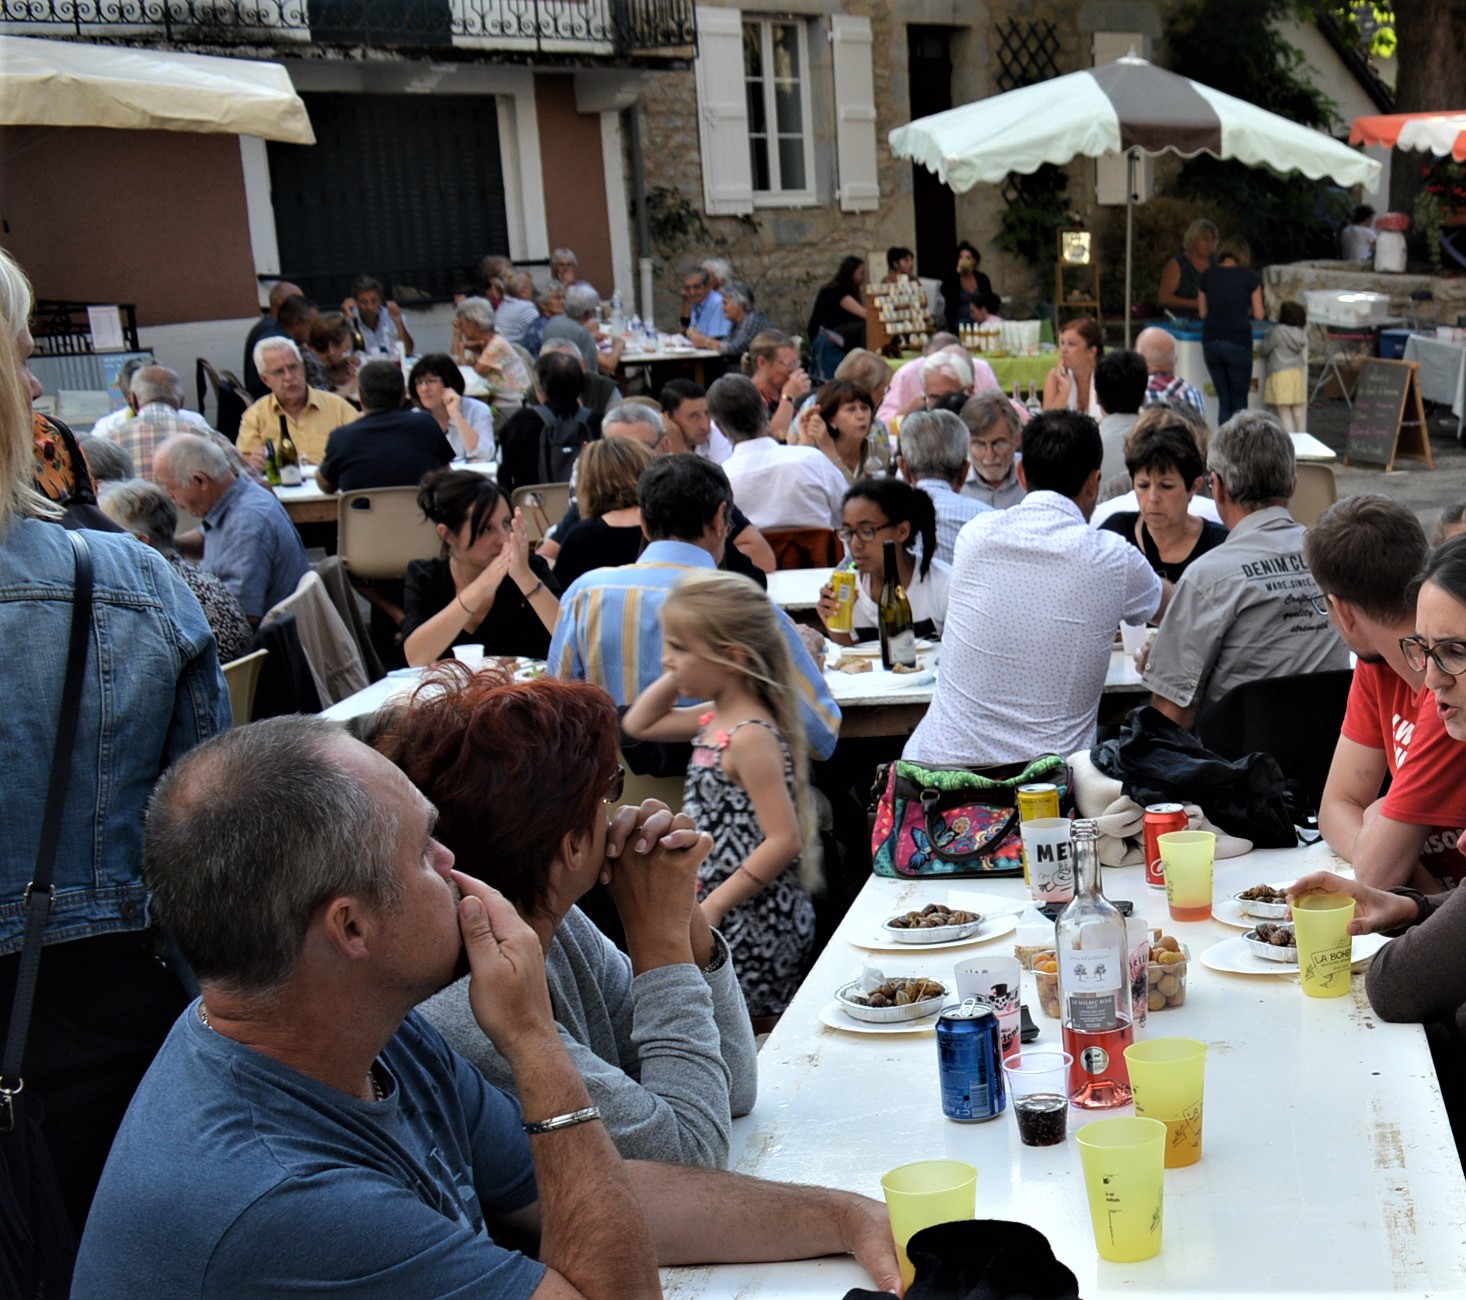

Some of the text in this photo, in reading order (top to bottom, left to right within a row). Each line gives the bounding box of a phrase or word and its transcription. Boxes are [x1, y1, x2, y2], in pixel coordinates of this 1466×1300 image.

[1241, 554, 1309, 578] DENIM CL
[1283, 609, 1314, 621] quality
[1314, 954, 1328, 965] LA
